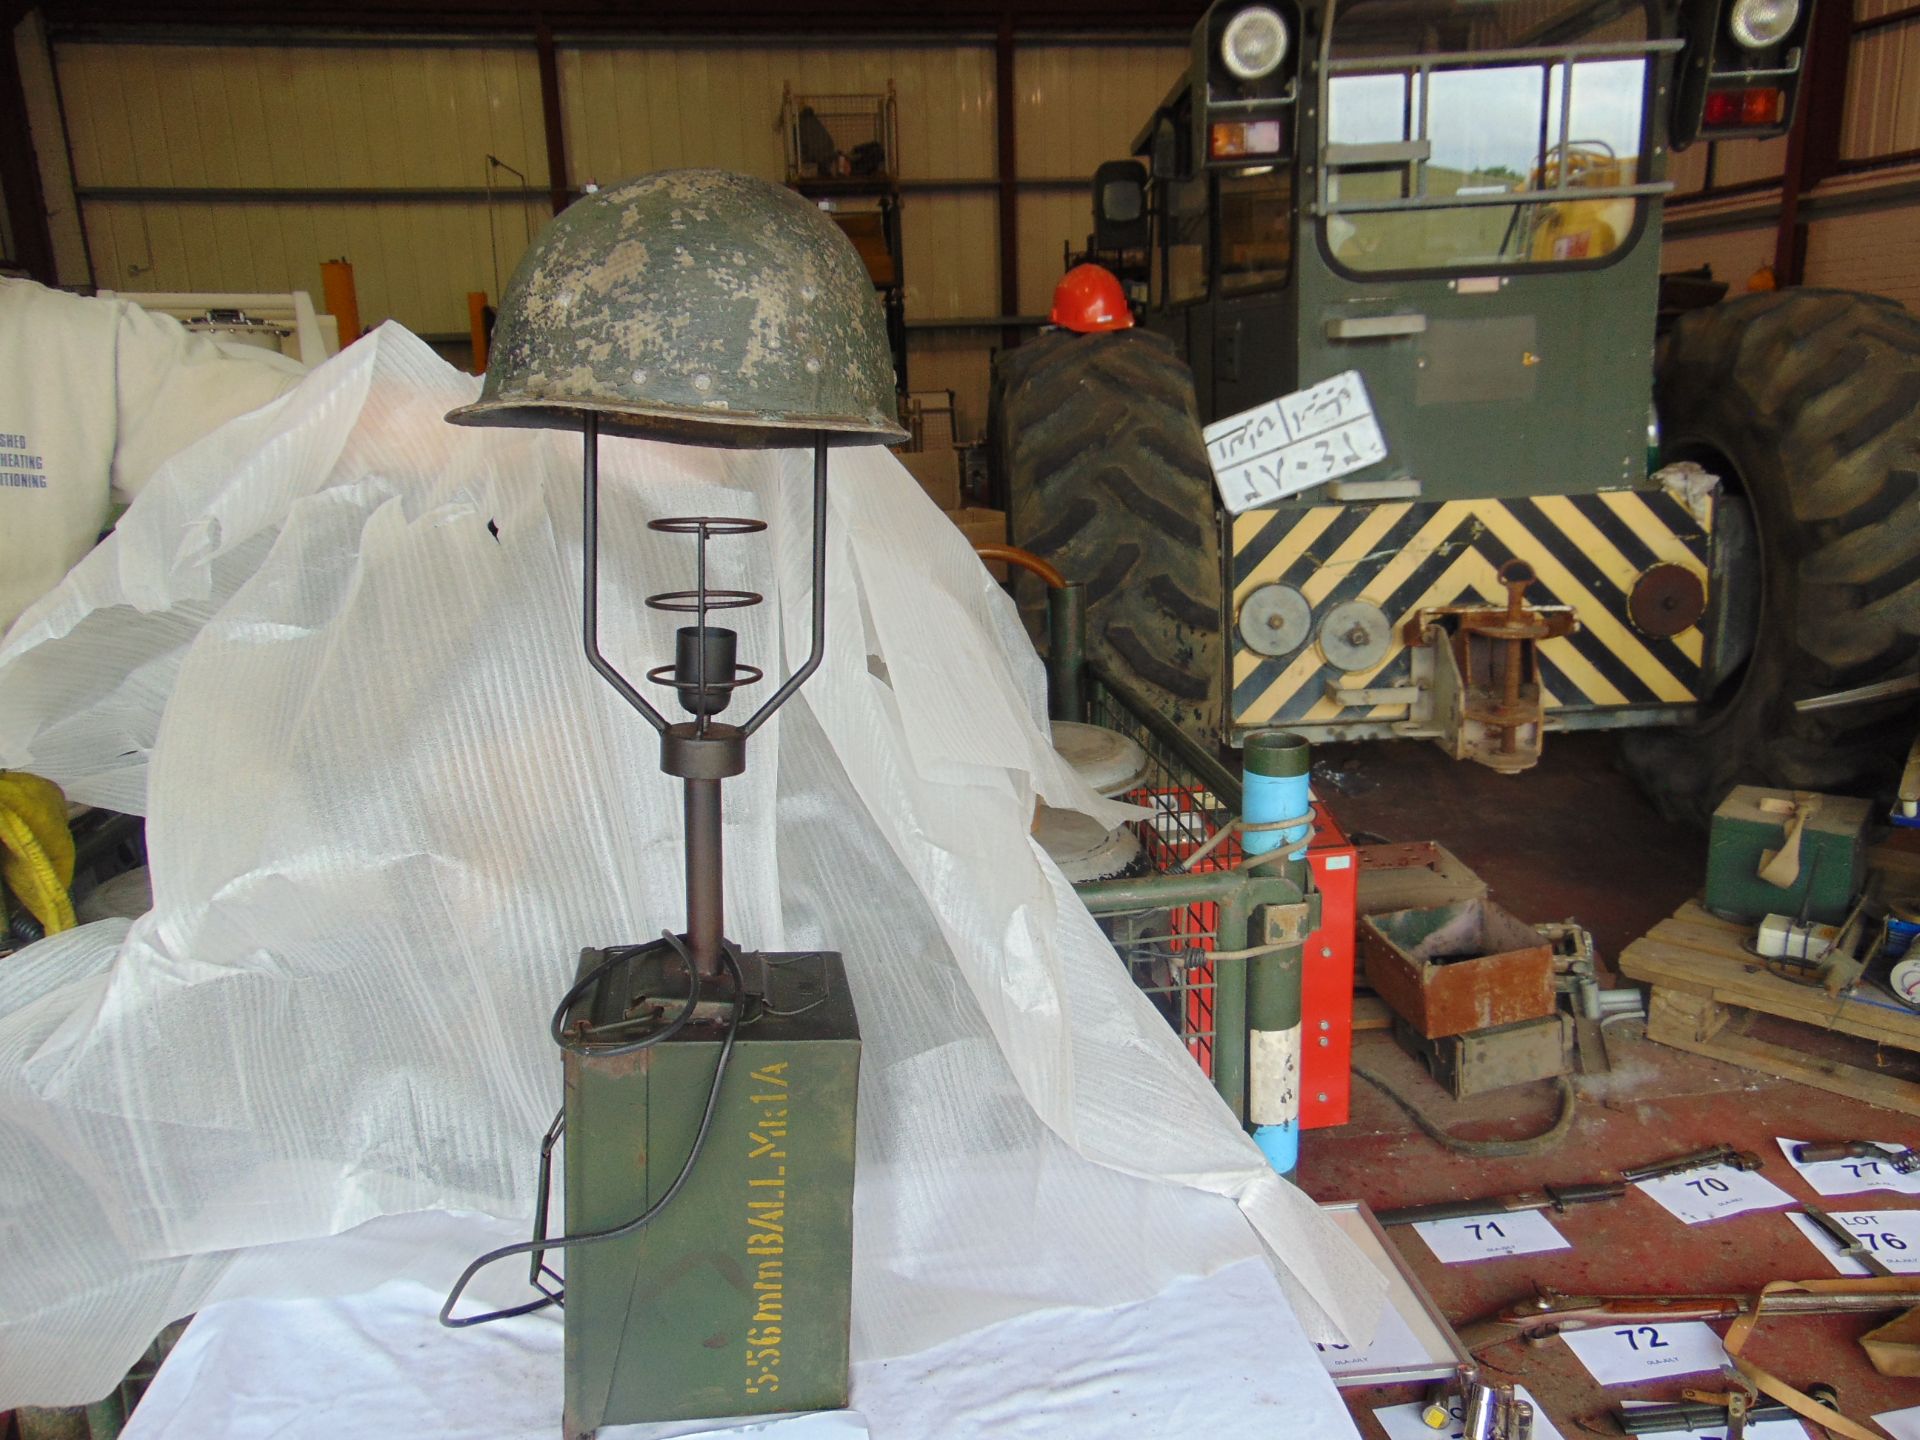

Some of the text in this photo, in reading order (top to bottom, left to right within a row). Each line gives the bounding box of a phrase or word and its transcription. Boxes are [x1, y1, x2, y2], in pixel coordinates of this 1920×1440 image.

[1841, 1161, 1881, 1178] 77
[1685, 1177, 1729, 1196] 70
[747, 1165, 785, 1256] BALL
[1841, 1215, 1879, 1225] LOT
[1464, 1221, 1506, 1240] 71
[1857, 1232, 1907, 1251] 76
[1614, 1326, 1669, 1350] 72
